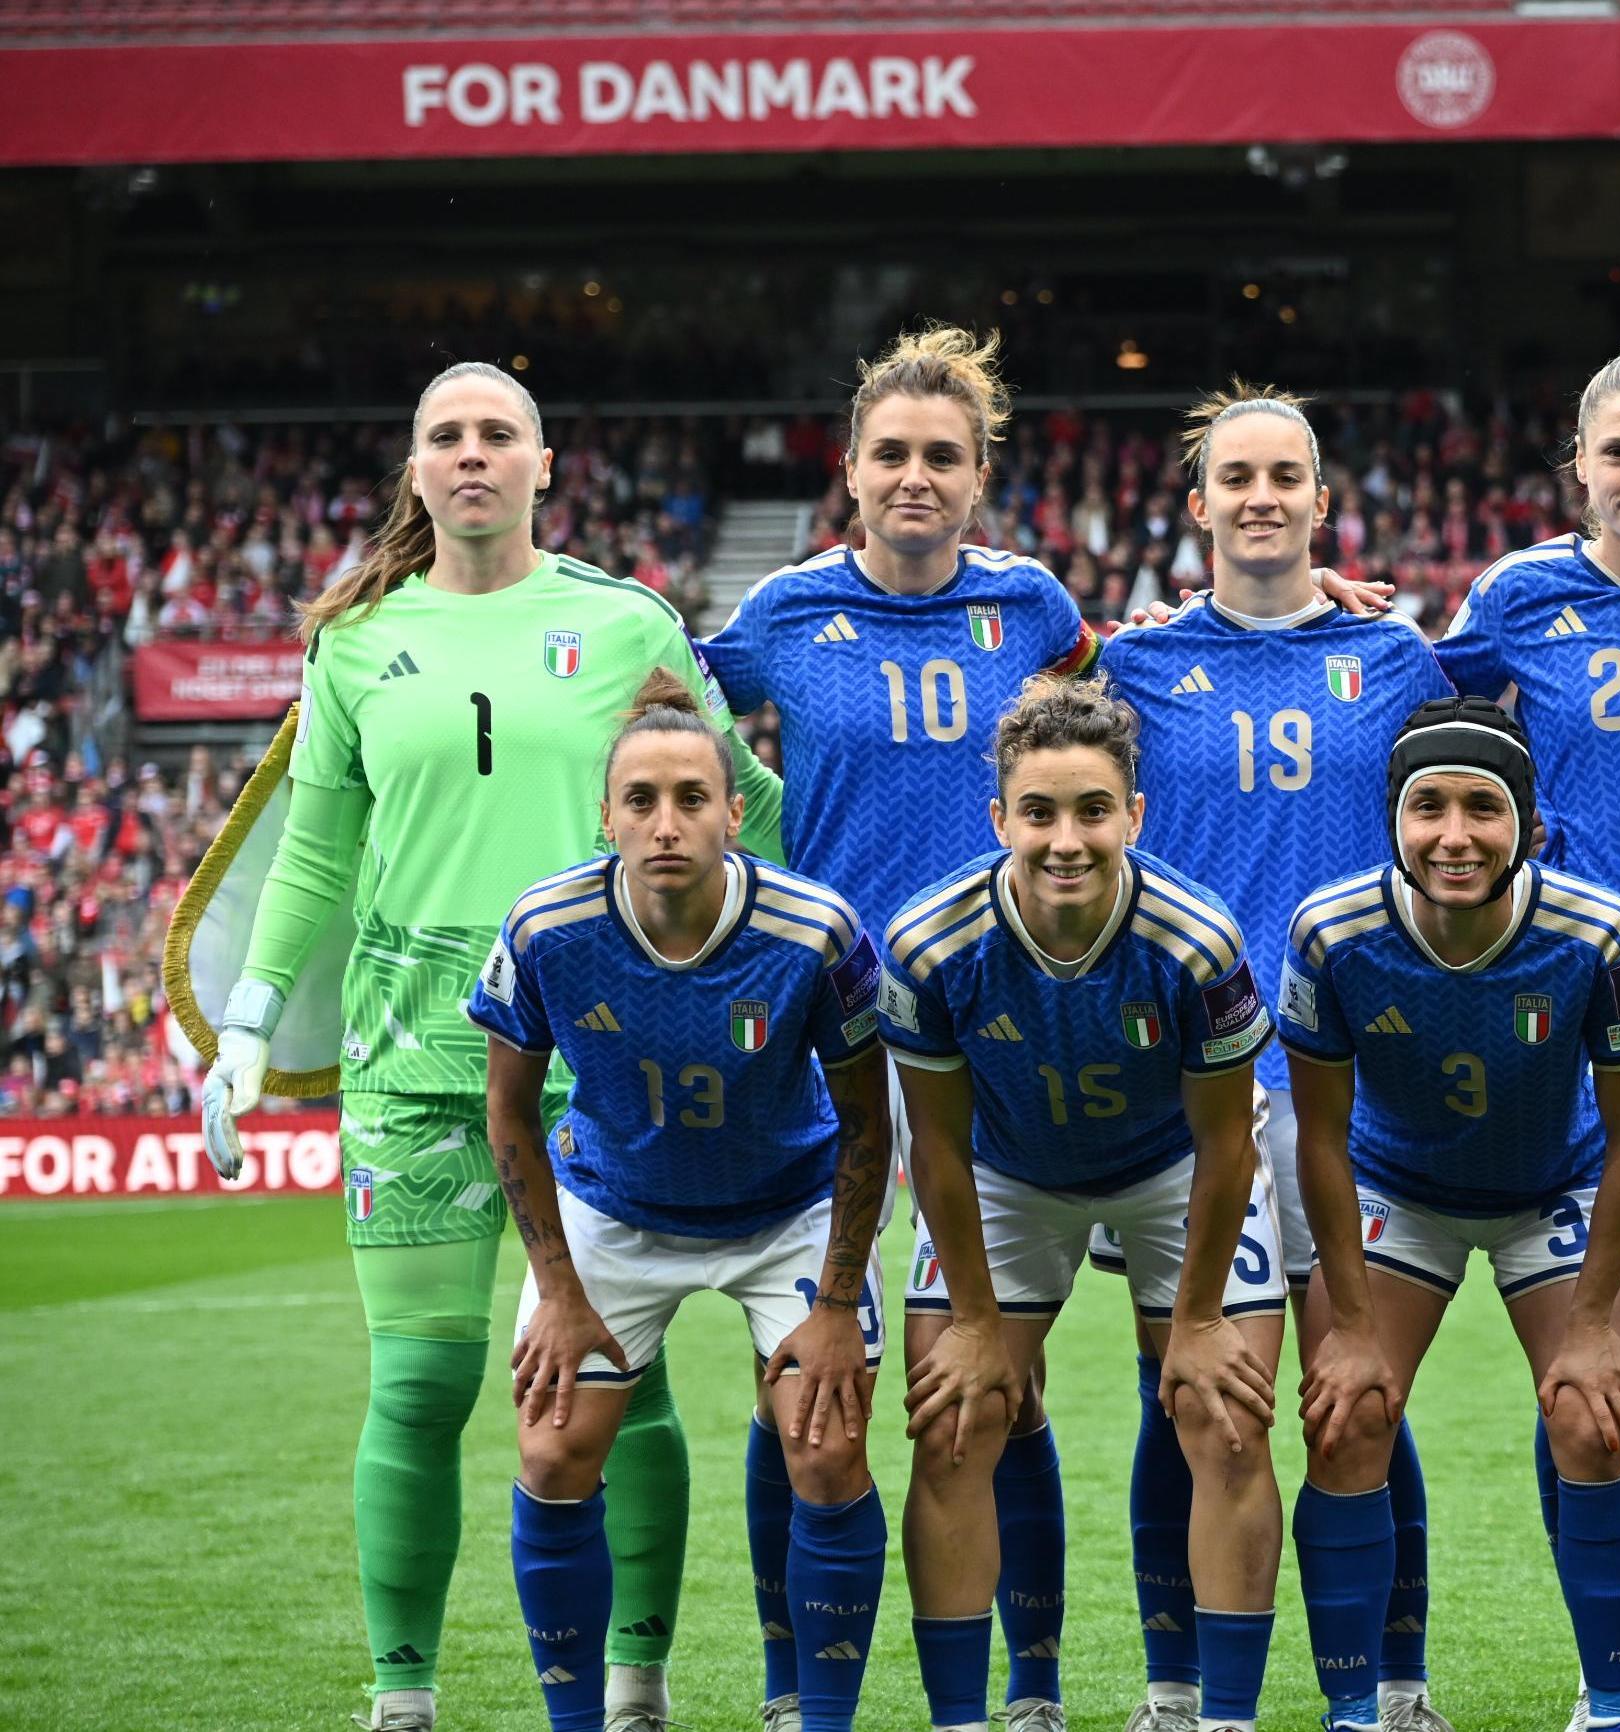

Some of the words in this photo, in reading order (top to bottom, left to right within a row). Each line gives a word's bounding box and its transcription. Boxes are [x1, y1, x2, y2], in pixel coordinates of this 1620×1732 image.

[403, 63, 561, 127] FOR
[580, 56, 979, 122] DANMARK
[969, 605, 997, 616] ITALIA
[547, 634, 577, 645] ITALIA
[1328, 658, 1358, 669] ITALIA
[880, 658, 968, 743] 10
[469, 691, 492, 776] 1
[1230, 708, 1312, 793] 19
[733, 1002, 765, 1014] ITALIA
[1123, 1005, 1156, 1015] ITALIA
[1215, 993, 1256, 1024] EUROPEAN
[1517, 997, 1548, 1009] ITALIA
[1205, 1013, 1267, 1056] FOUNDATION
[639, 1058, 724, 1129] 13
[1037, 1063, 1127, 1126] 15
[1441, 1052, 1488, 1118] 3
[0, 1135, 117, 1194] FOR
[125, 1133, 204, 1191] AT
[219, 1131, 340, 1190] STØ
[352, 1173, 369, 1184] ITALIA
[1360, 1203, 1385, 1217] TALIA
[1539, 1195, 1588, 1258] 3
[832, 1271, 857, 1290] 13
[805, 1601, 870, 1616] ITALIA
[1316, 1655, 1368, 1671] TALIA
